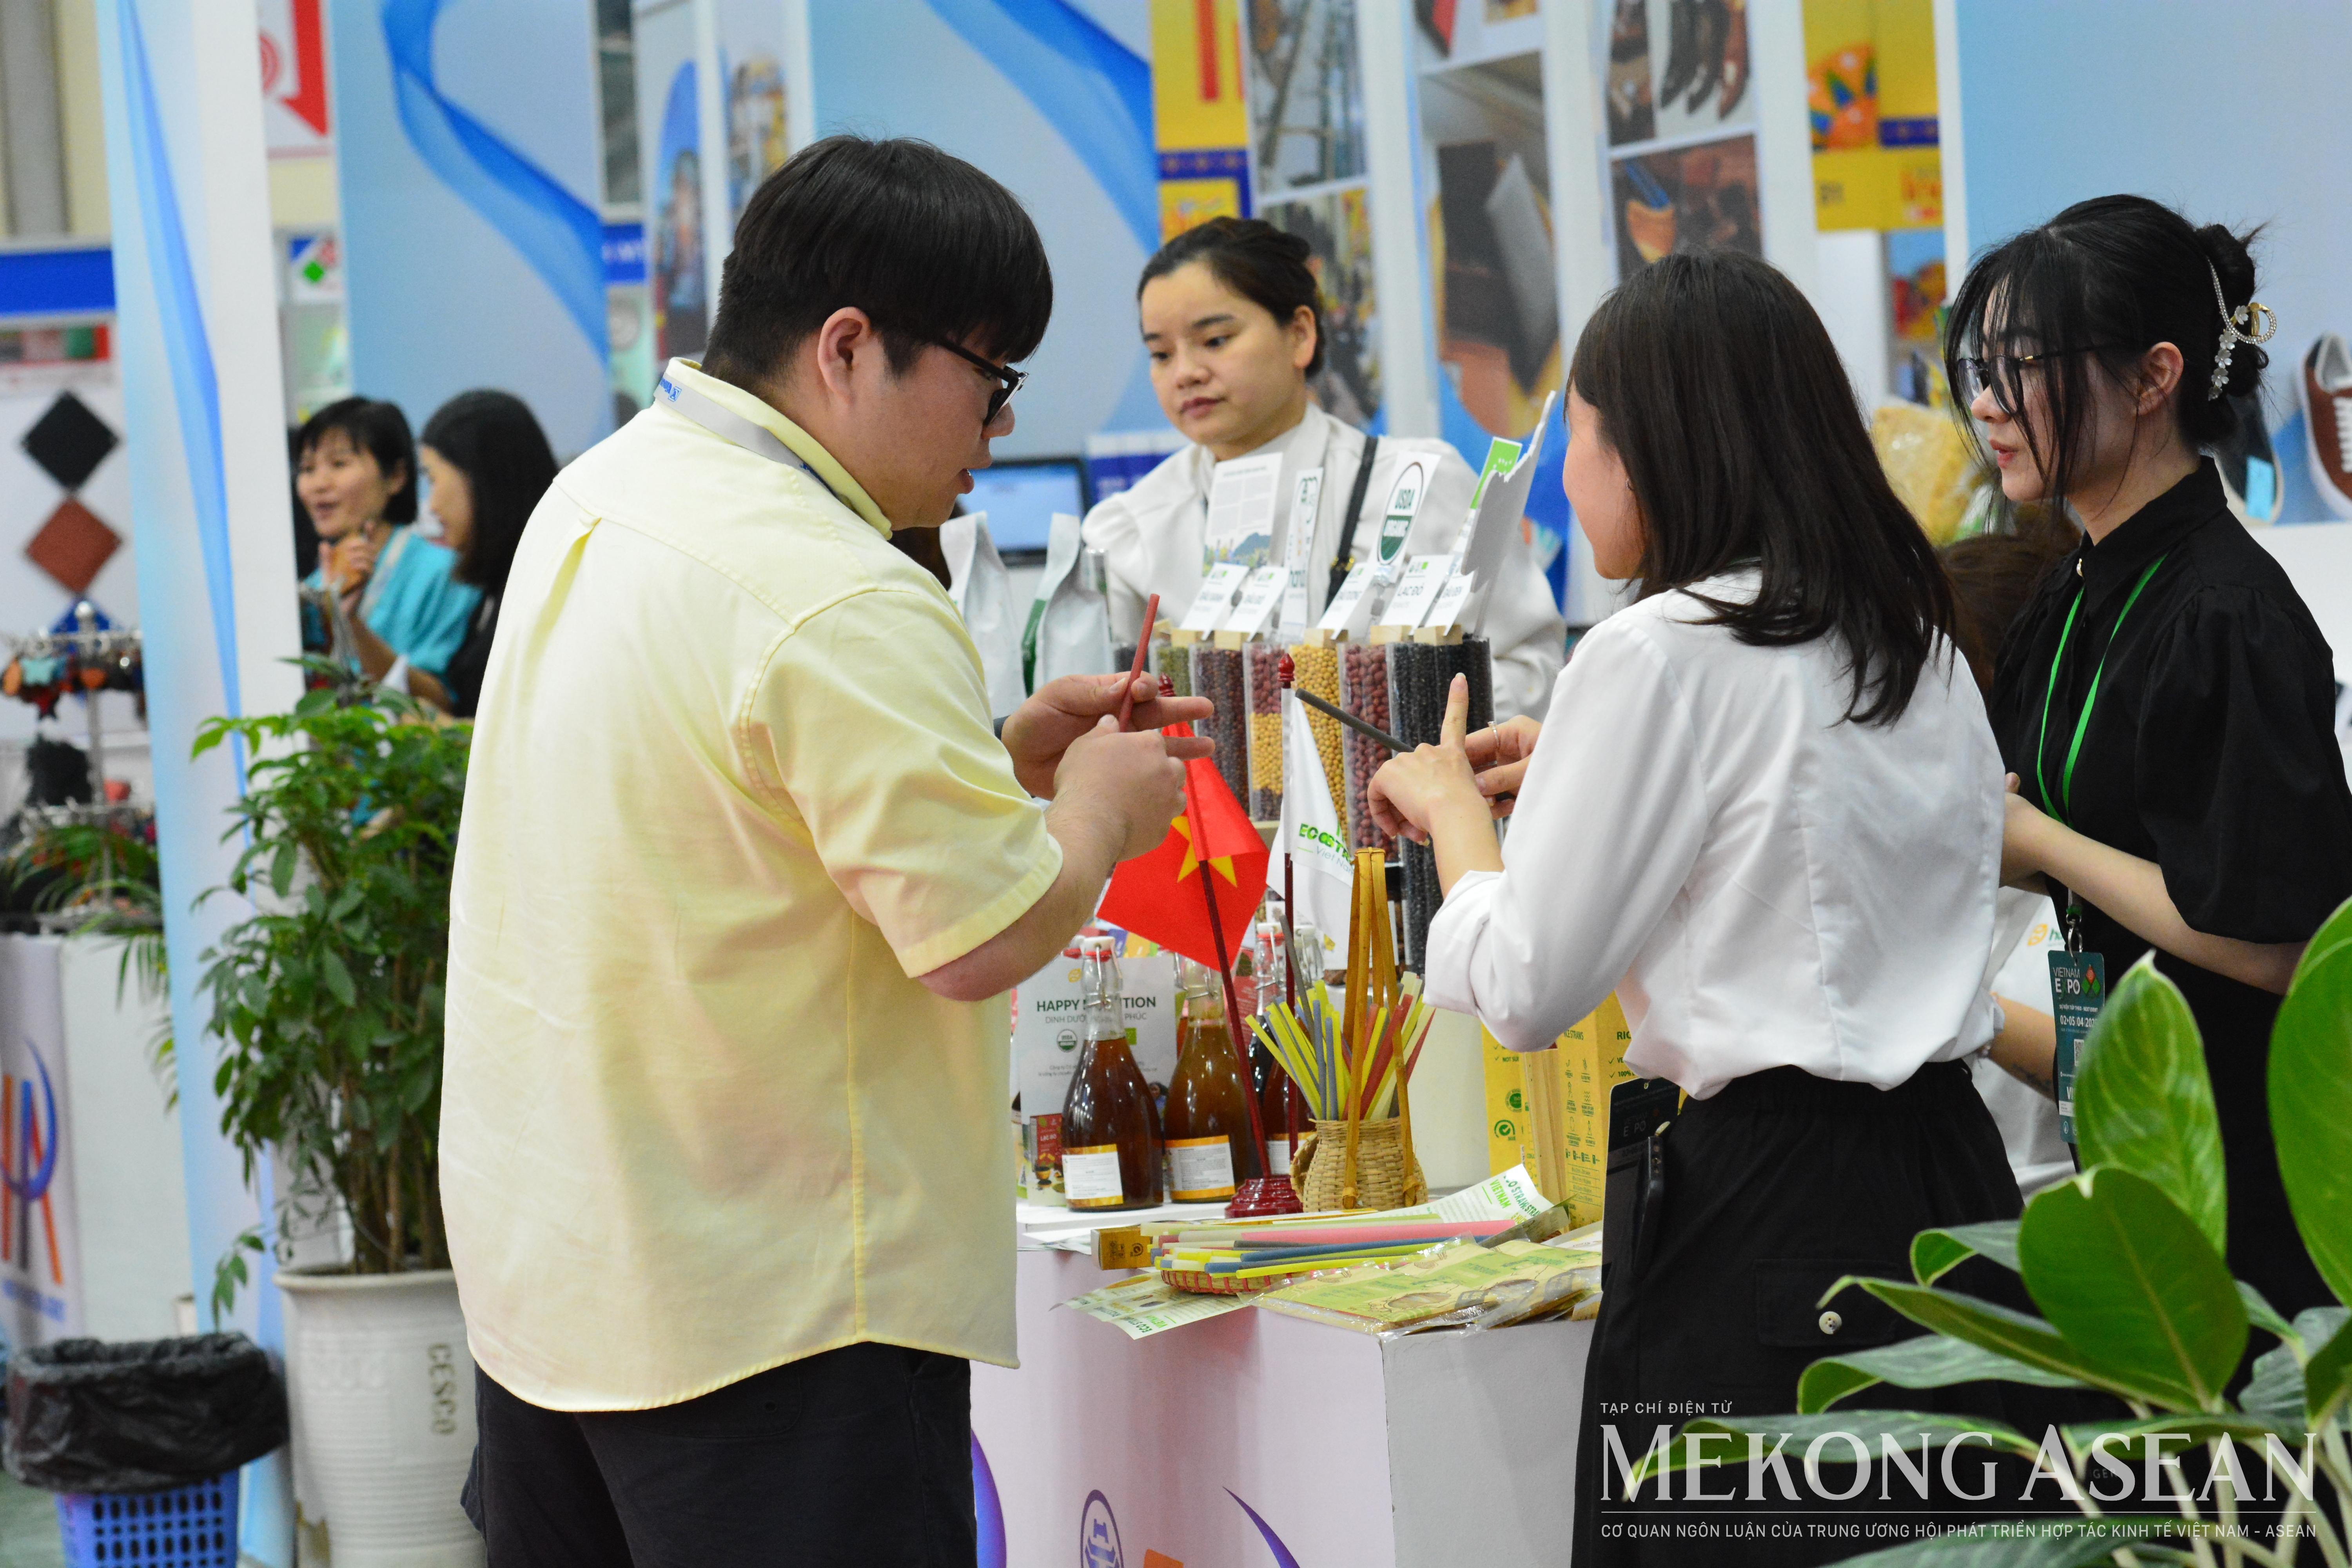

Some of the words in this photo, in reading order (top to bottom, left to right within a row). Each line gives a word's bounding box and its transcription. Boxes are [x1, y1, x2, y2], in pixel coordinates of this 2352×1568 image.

[2053, 967, 2080, 978] VIETNAM
[1037, 999, 1080, 1012] HAPPY
[1617, 1031, 1631, 1040] RIC
[1490, 1179, 1512, 1209] VIETNAM
